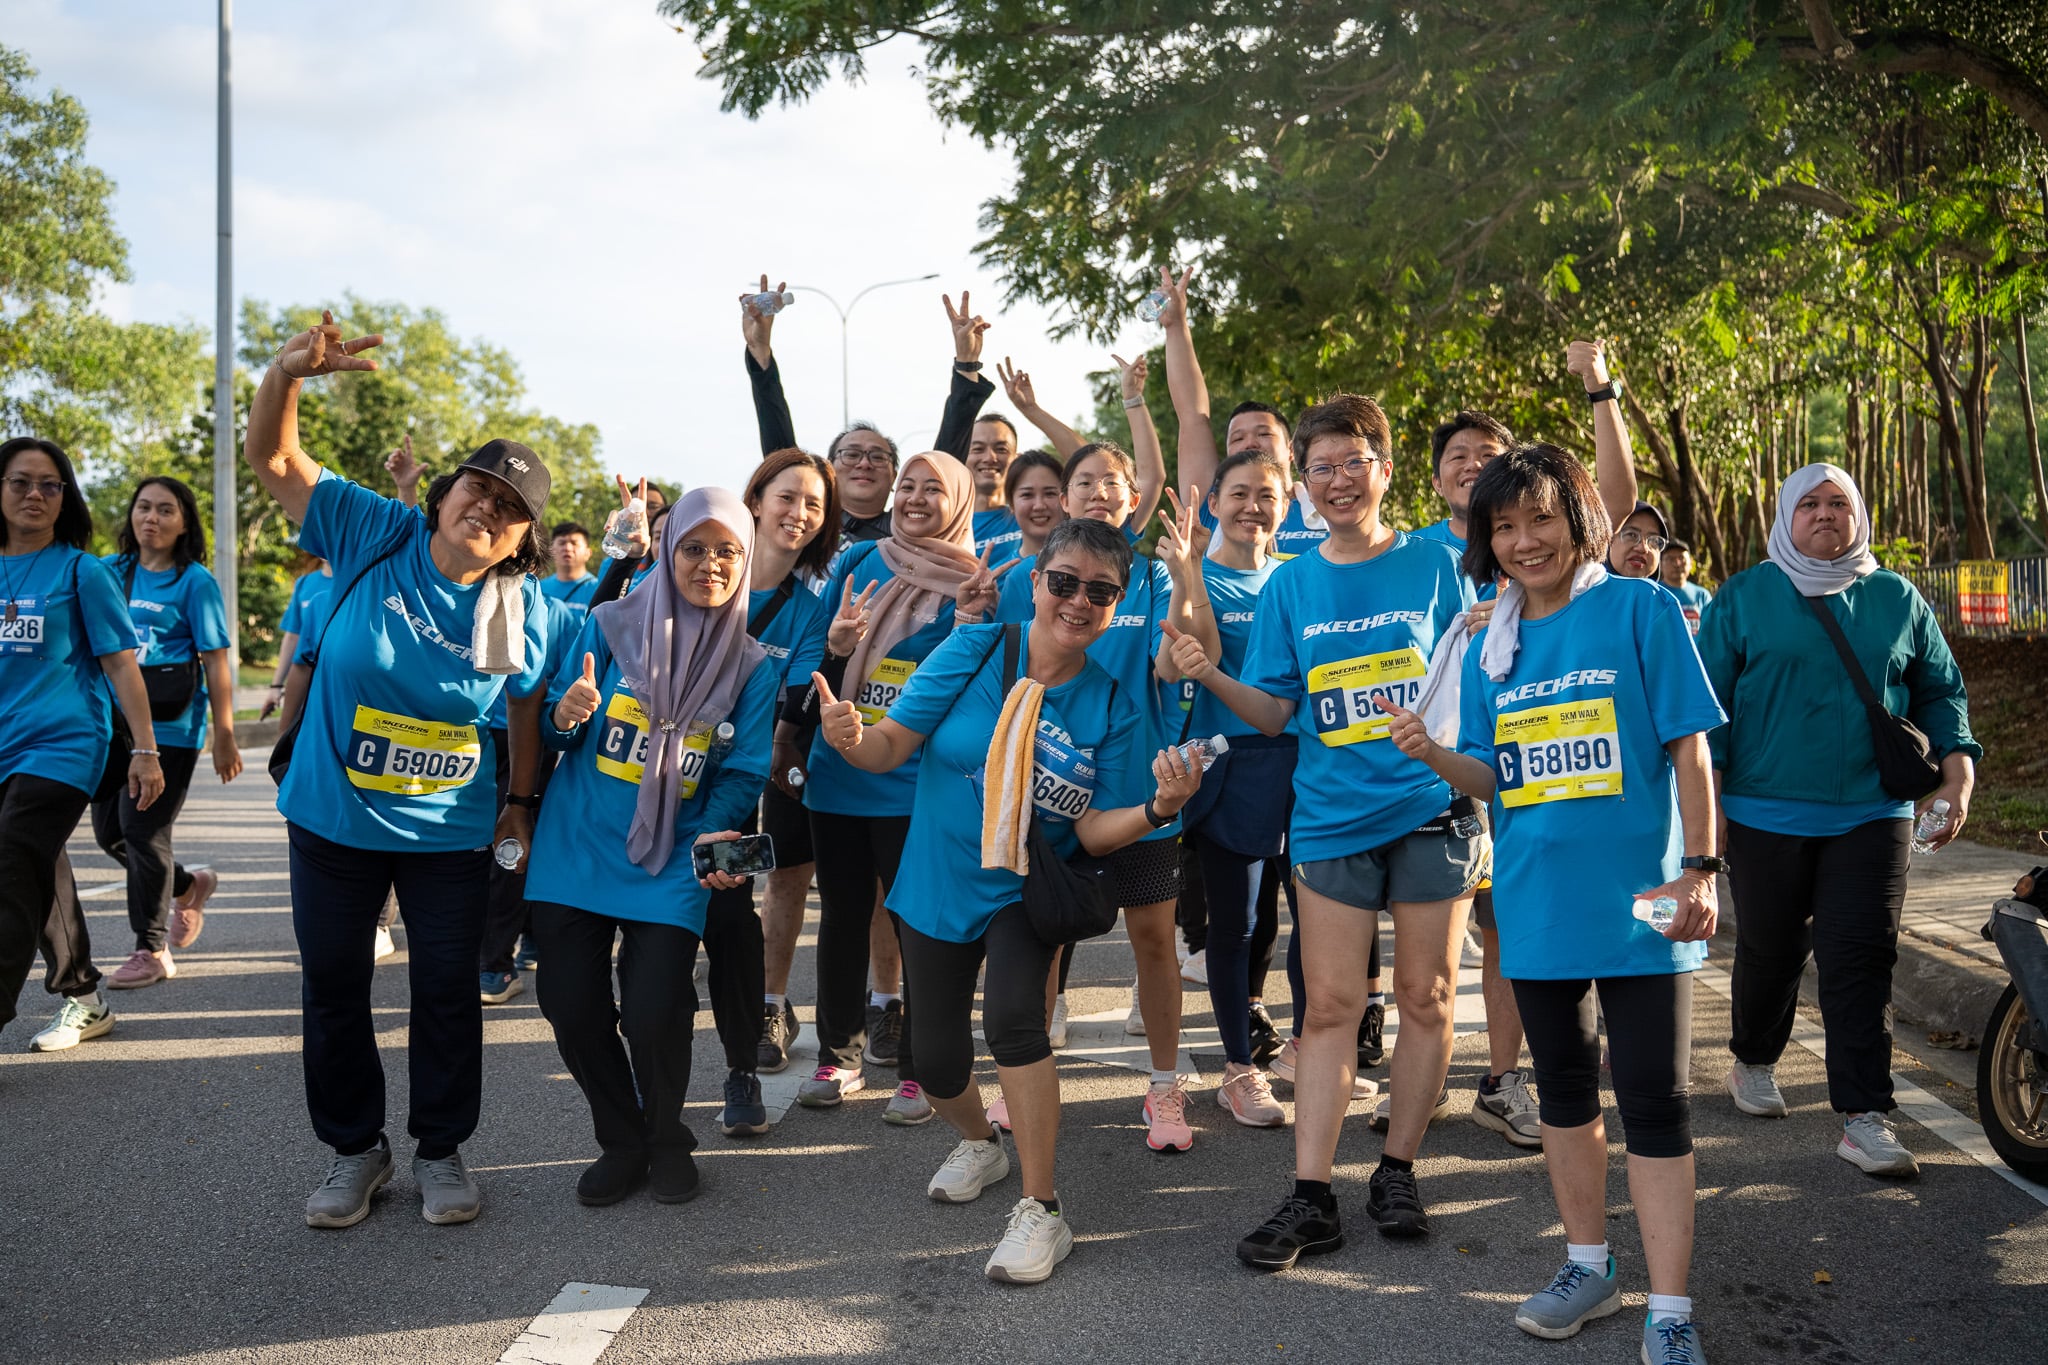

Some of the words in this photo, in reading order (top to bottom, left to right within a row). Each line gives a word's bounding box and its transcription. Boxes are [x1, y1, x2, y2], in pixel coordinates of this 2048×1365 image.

[1979, 564, 2005, 577] RENT
[1302, 610, 1425, 641] SKECHERS
[1327, 663, 1371, 677] SKECHERS
[1380, 659, 1395, 669] 5KM
[1395, 656, 1411, 667] WALK
[1183, 682, 1194, 699] C
[1496, 669, 1618, 709] SKECHERS
[1320, 697, 1337, 726] C
[1503, 714, 1549, 729] SKECHERS
[1560, 711, 1577, 721] 5KM
[1578, 708, 1599, 719] WALK
[381, 719, 430, 734] SKECHERS
[438, 729, 453, 738] 5KM
[605, 726, 625, 753] C
[357, 740, 376, 767] C
[392, 747, 475, 779] 59067
[1498, 751, 1514, 783] C
[1528, 737, 1612, 778] 58190
